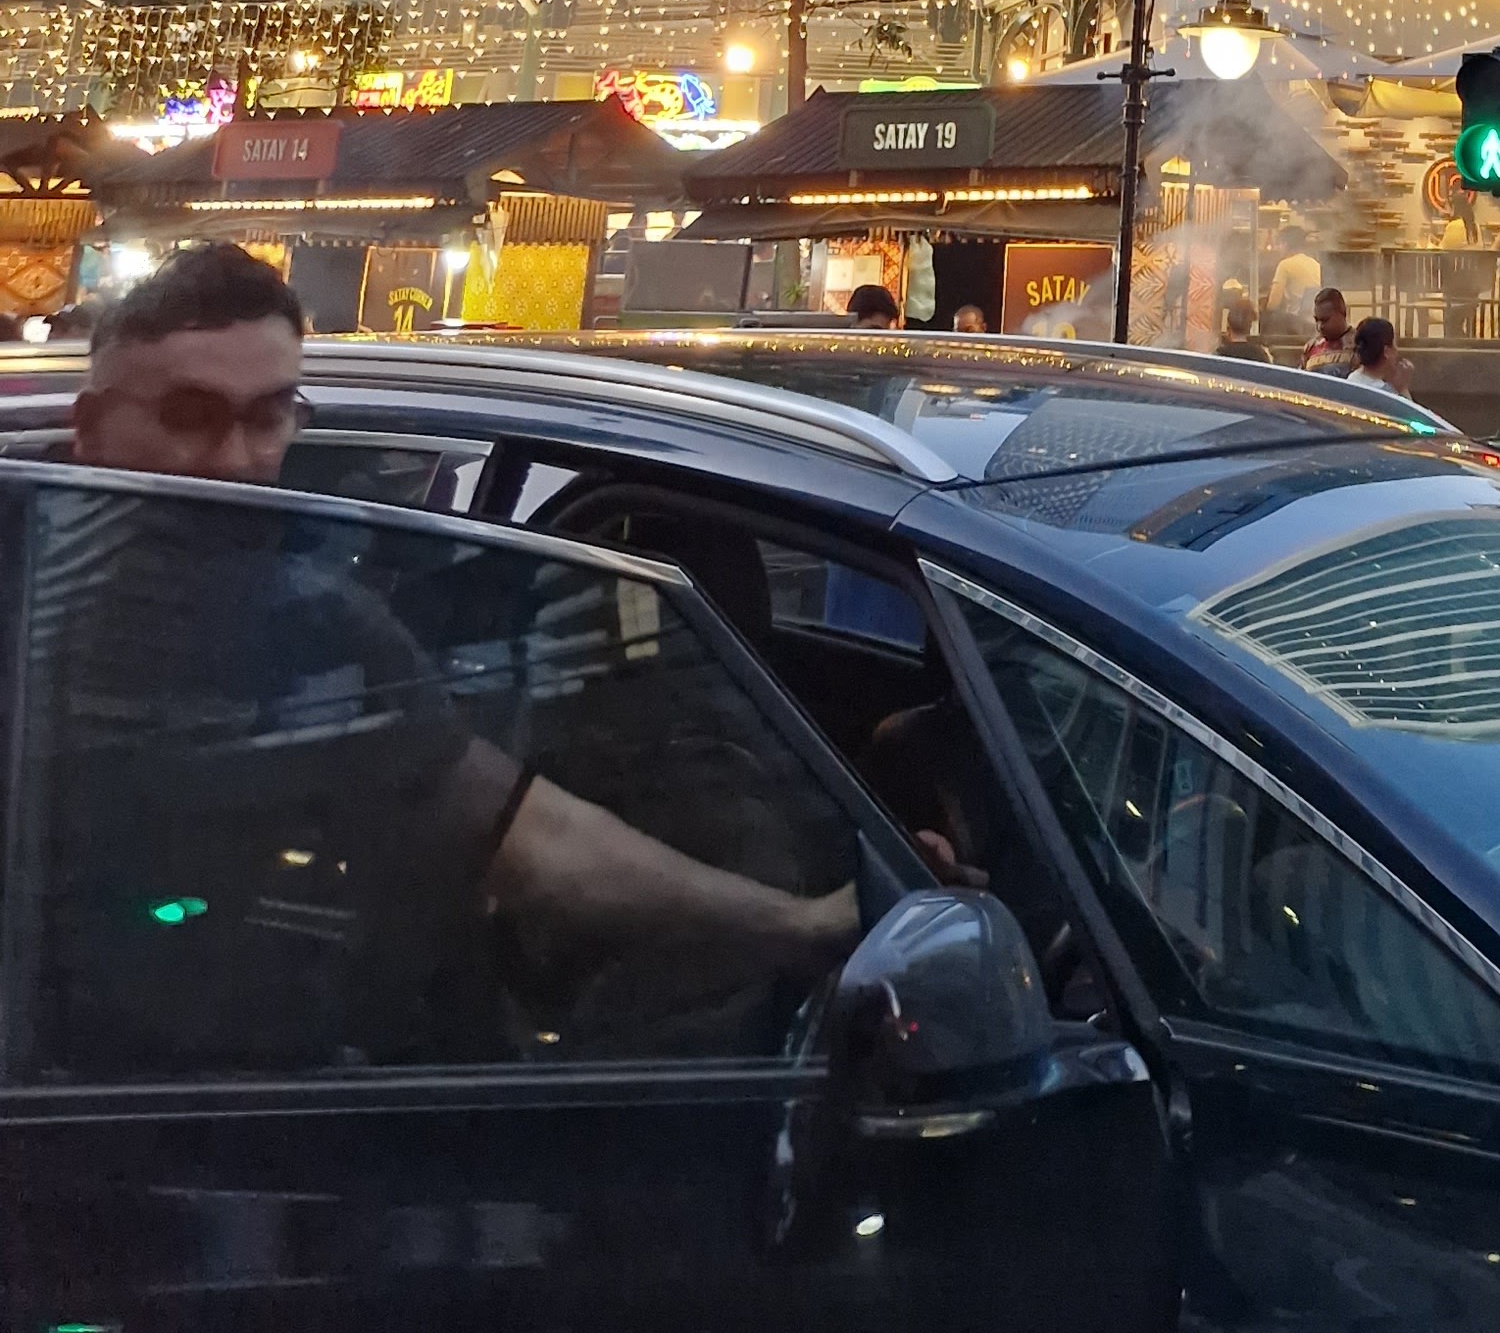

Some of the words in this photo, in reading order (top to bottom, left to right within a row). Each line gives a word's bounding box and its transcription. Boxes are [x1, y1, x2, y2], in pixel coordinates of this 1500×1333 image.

[242, 138, 288, 162] SATAY
[291, 137, 310, 162] 14
[873, 122, 929, 151] SATAY
[935, 121, 957, 149] 19
[387, 286, 410, 306] SATAY
[1026, 274, 1091, 307] SATAY
[393, 304, 415, 333] 14
